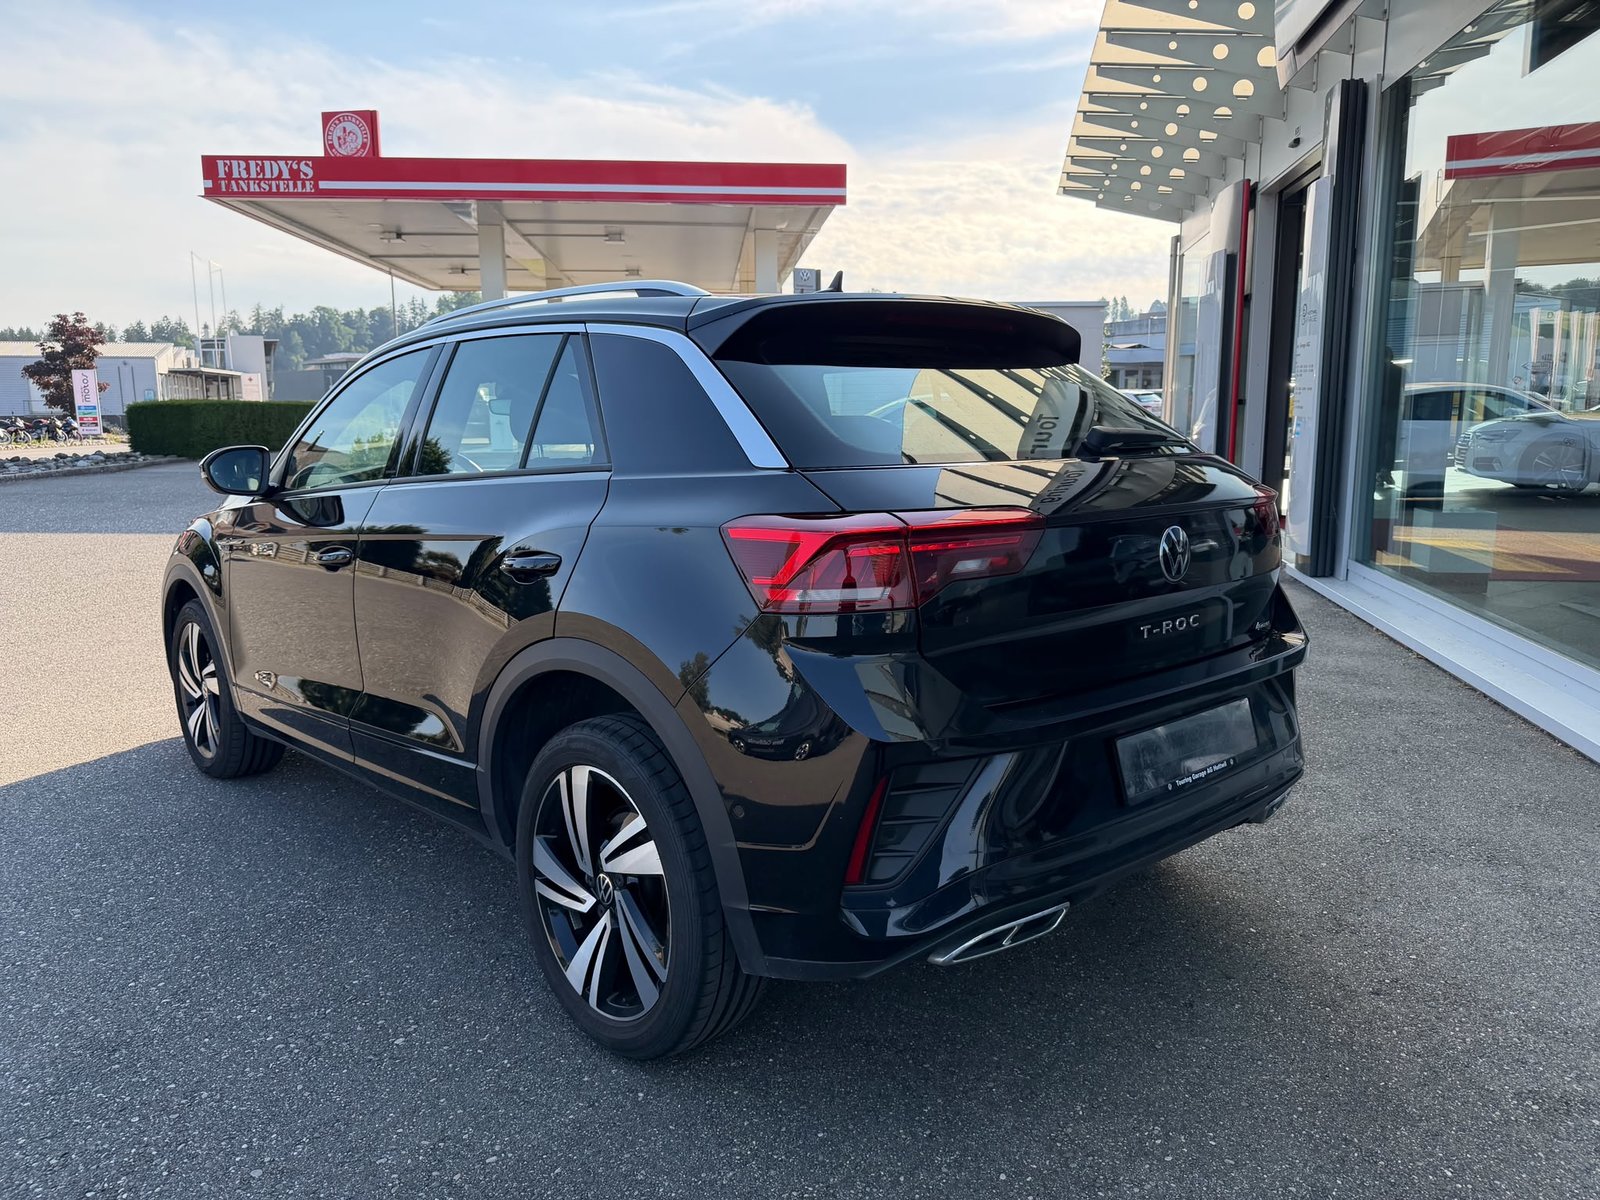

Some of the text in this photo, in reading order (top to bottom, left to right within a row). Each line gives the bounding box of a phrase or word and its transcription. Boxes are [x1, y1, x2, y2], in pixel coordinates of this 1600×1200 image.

[216, 160, 314, 179] FREDY'S
[218, 180, 315, 192] TANKSTELLE
[1140, 614, 1200, 639] T-ROC
[1176, 776, 1192, 787] Touring
[1192, 771, 1206, 780] Garage
